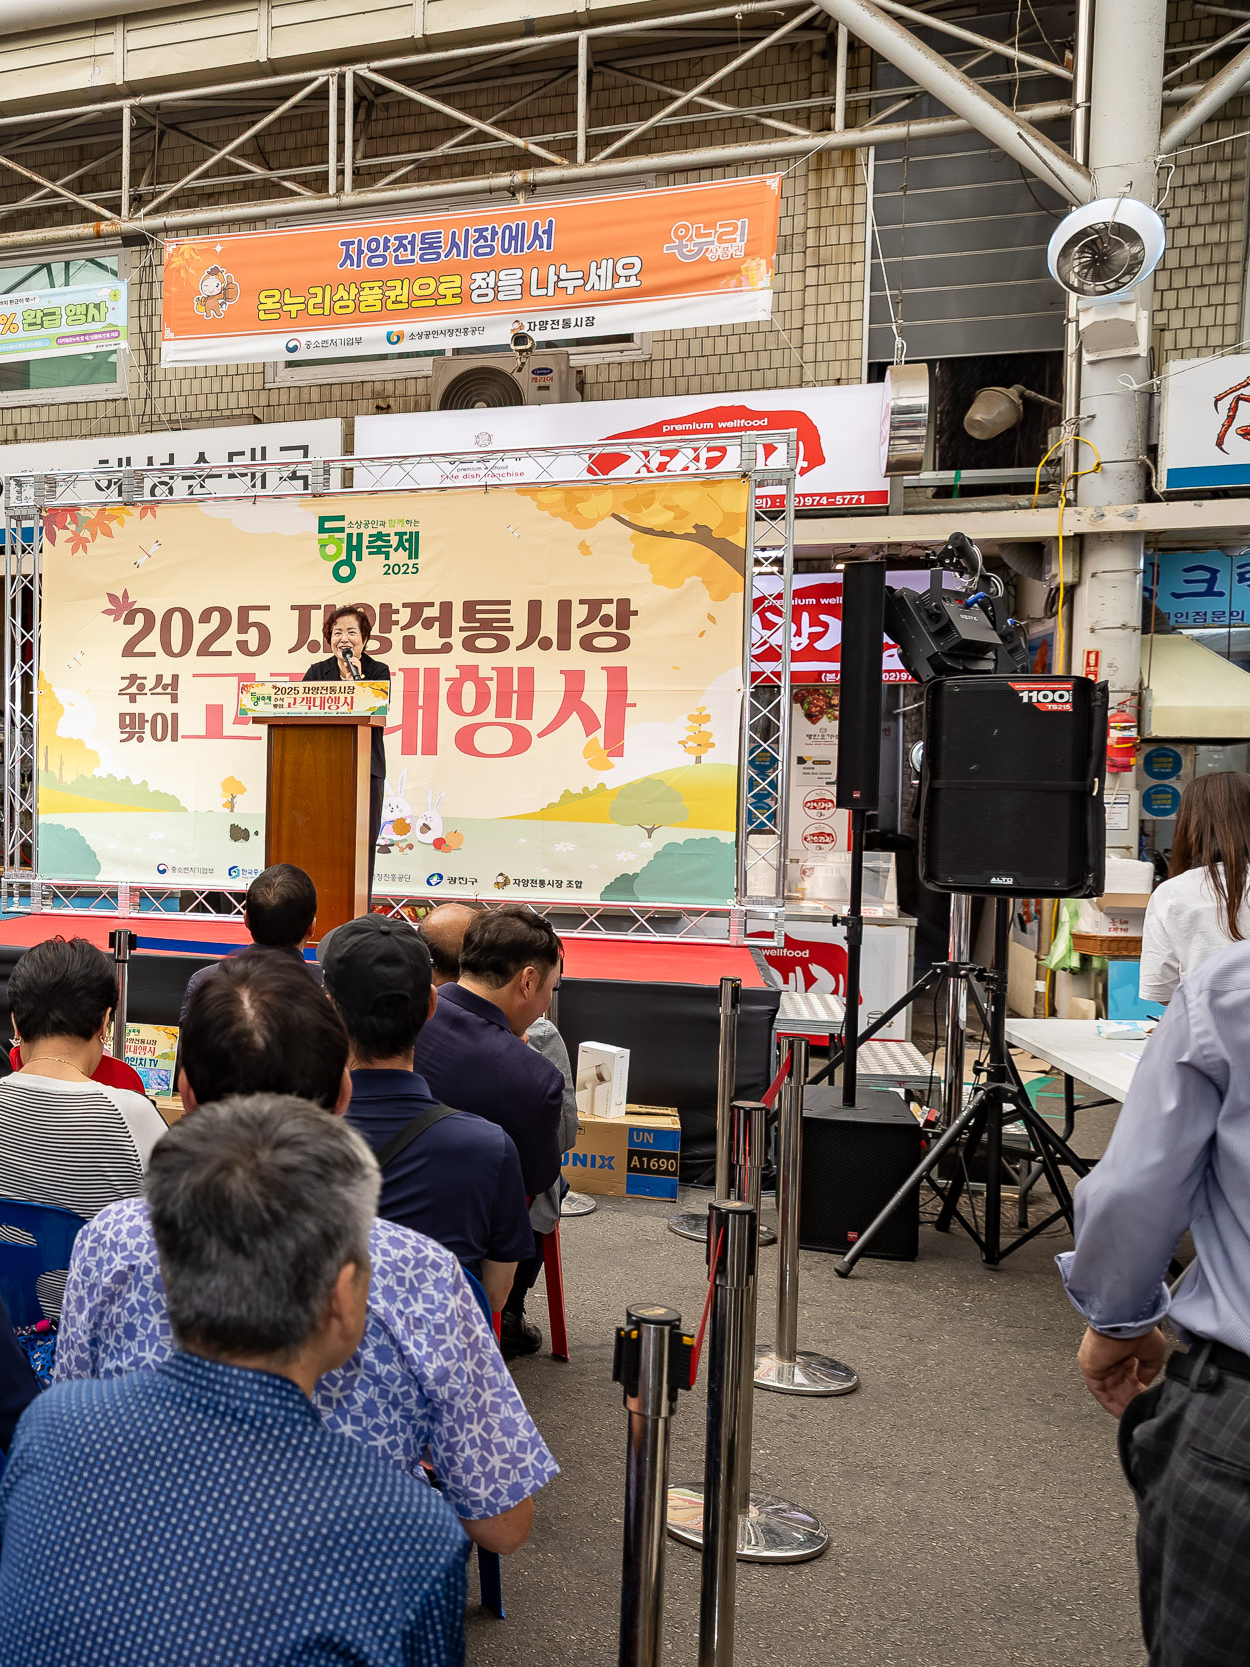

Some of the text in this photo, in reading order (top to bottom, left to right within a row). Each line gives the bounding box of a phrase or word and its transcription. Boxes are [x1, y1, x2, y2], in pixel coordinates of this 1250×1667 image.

[338, 218, 556, 270] 자양전통시장에서
[257, 256, 643, 321] 온누리상품권으로 정을 나누세요
[22, 307, 61, 331] 환급
[65, 301, 108, 325] 행사
[304, 316, 596, 350] 중소벤처기업부 소상공인시장진흥공단 자양전통시장
[662, 418, 768, 433] premium wellfood
[784, 495, 866, 507] 2)974-5771
[347, 518, 420, 529] 소상공인과 함께하는
[382, 563, 419, 575] 2025
[1164, 609, 1246, 624] 인점문의
[120, 604, 272, 658] 2025
[118, 673, 179, 704] 추석
[273, 685, 356, 695] 2025 자양전통시장
[284, 696, 355, 711] 고객대행사
[1018, 690, 1069, 703] 1100
[180, 664, 638, 758] 고대행사
[118, 711, 179, 743] 맞이
[373, 873, 411, 883] 장진흥공단
[446, 876, 478, 885] 광진구
[512, 878, 563, 888] 자양전통시장
[566, 879, 583, 889] 조합
[761, 948, 810, 958] wellfood
[149, 1058, 159, 1067] TV
[633, 1131, 654, 1143] UN
[630, 1156, 676, 1172] A1690
